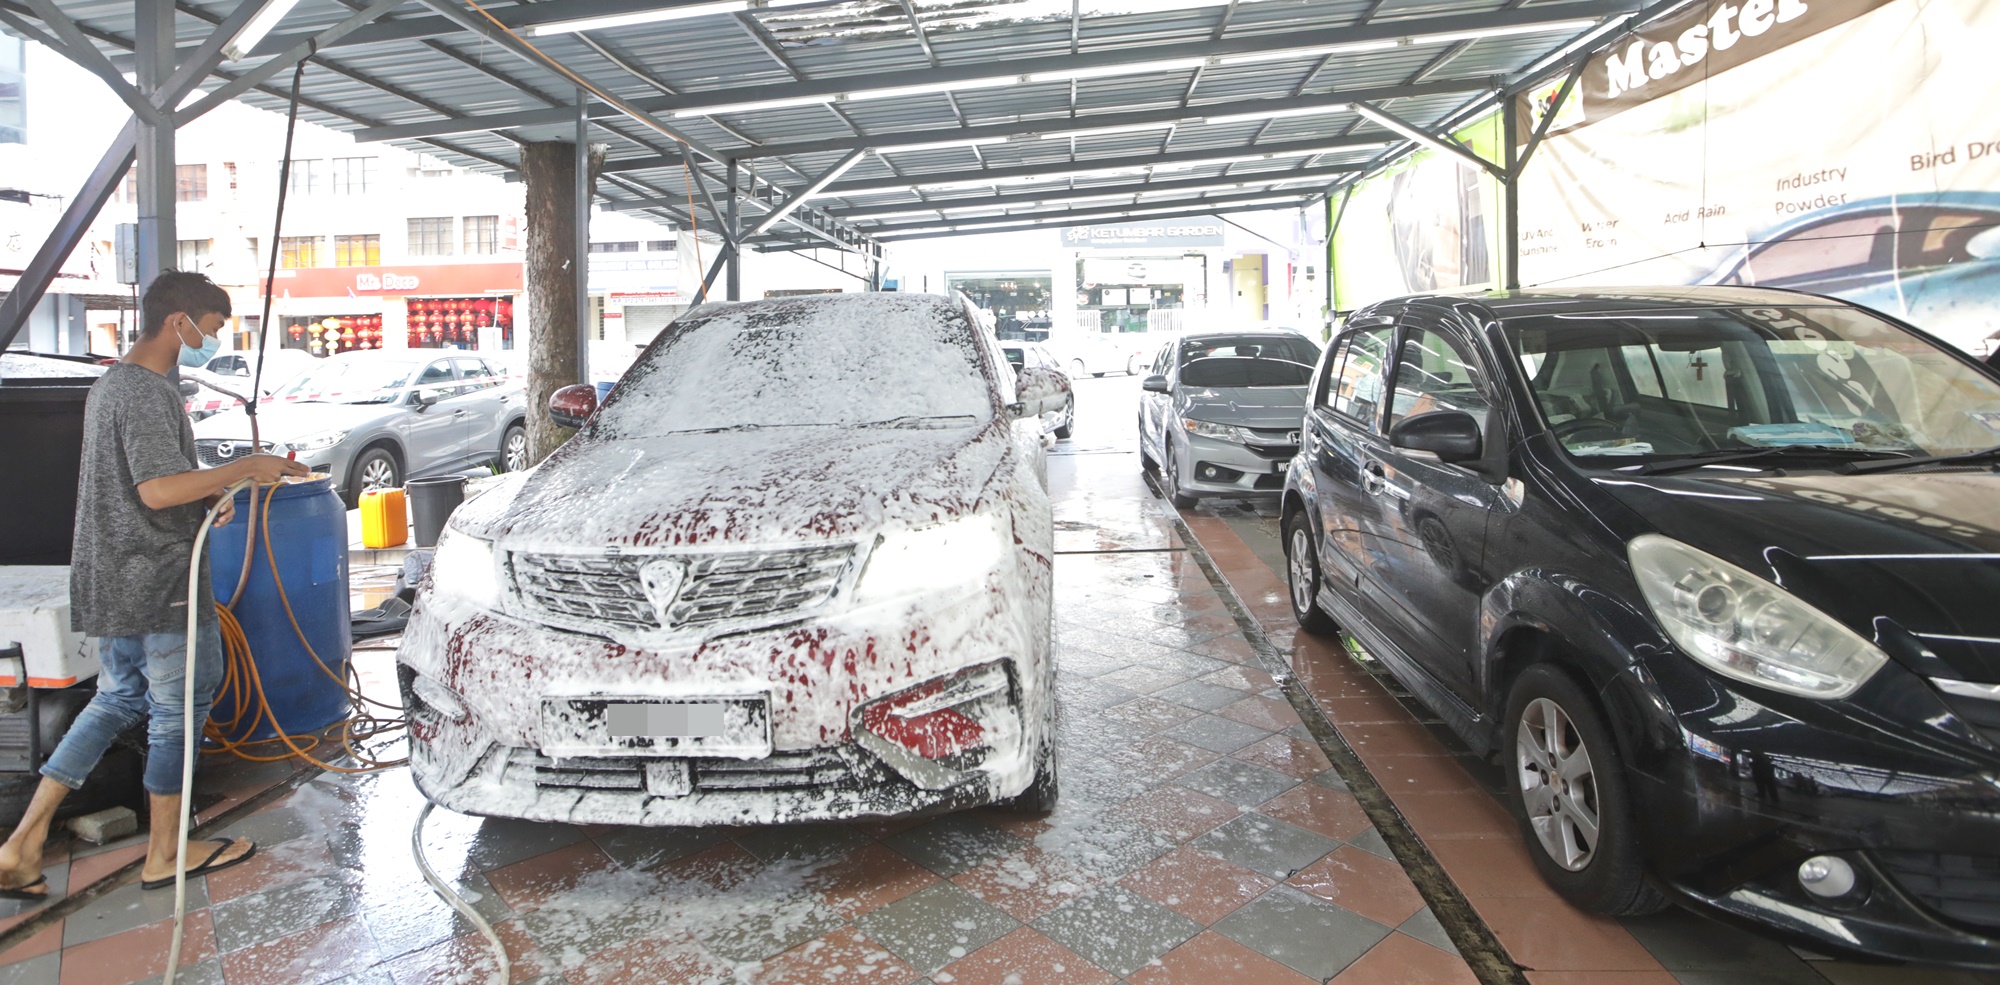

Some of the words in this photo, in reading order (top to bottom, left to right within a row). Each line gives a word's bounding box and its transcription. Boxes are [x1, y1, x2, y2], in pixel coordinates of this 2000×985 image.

[1910, 146, 1956, 171] Bird
[1776, 167, 1847, 191] Industry
[1775, 193, 1848, 214] Powder
[1664, 210, 1689, 225] Acid
[1697, 204, 1726, 219] Rain
[1091, 227, 1165, 238] KETUMBAR
[1167, 226, 1223, 237] GARDEN
[1581, 219, 1620, 233] Wer
[383, 272, 420, 291] Deco
